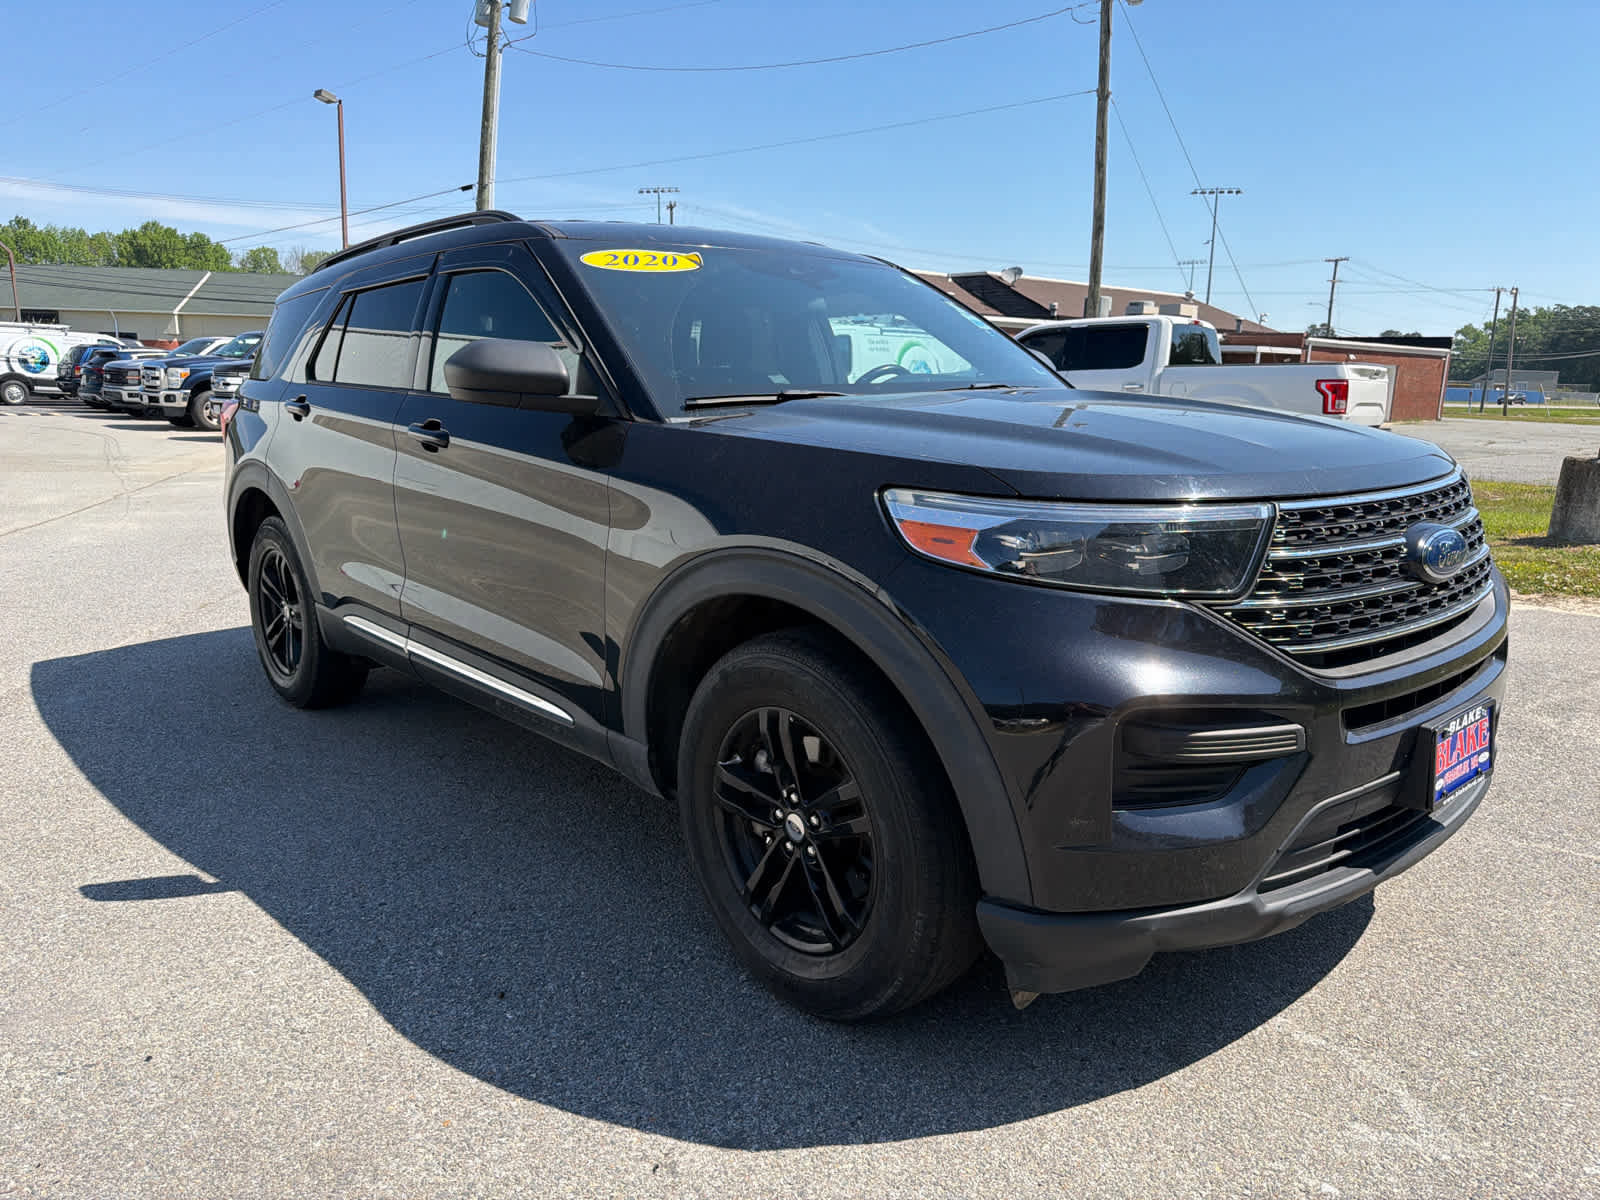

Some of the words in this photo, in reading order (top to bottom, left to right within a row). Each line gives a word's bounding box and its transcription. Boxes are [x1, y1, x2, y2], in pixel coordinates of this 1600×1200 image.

[604, 254, 678, 266] 2020
[1449, 706, 1483, 735] BLAKE
[1435, 718, 1489, 776] BLAKE
